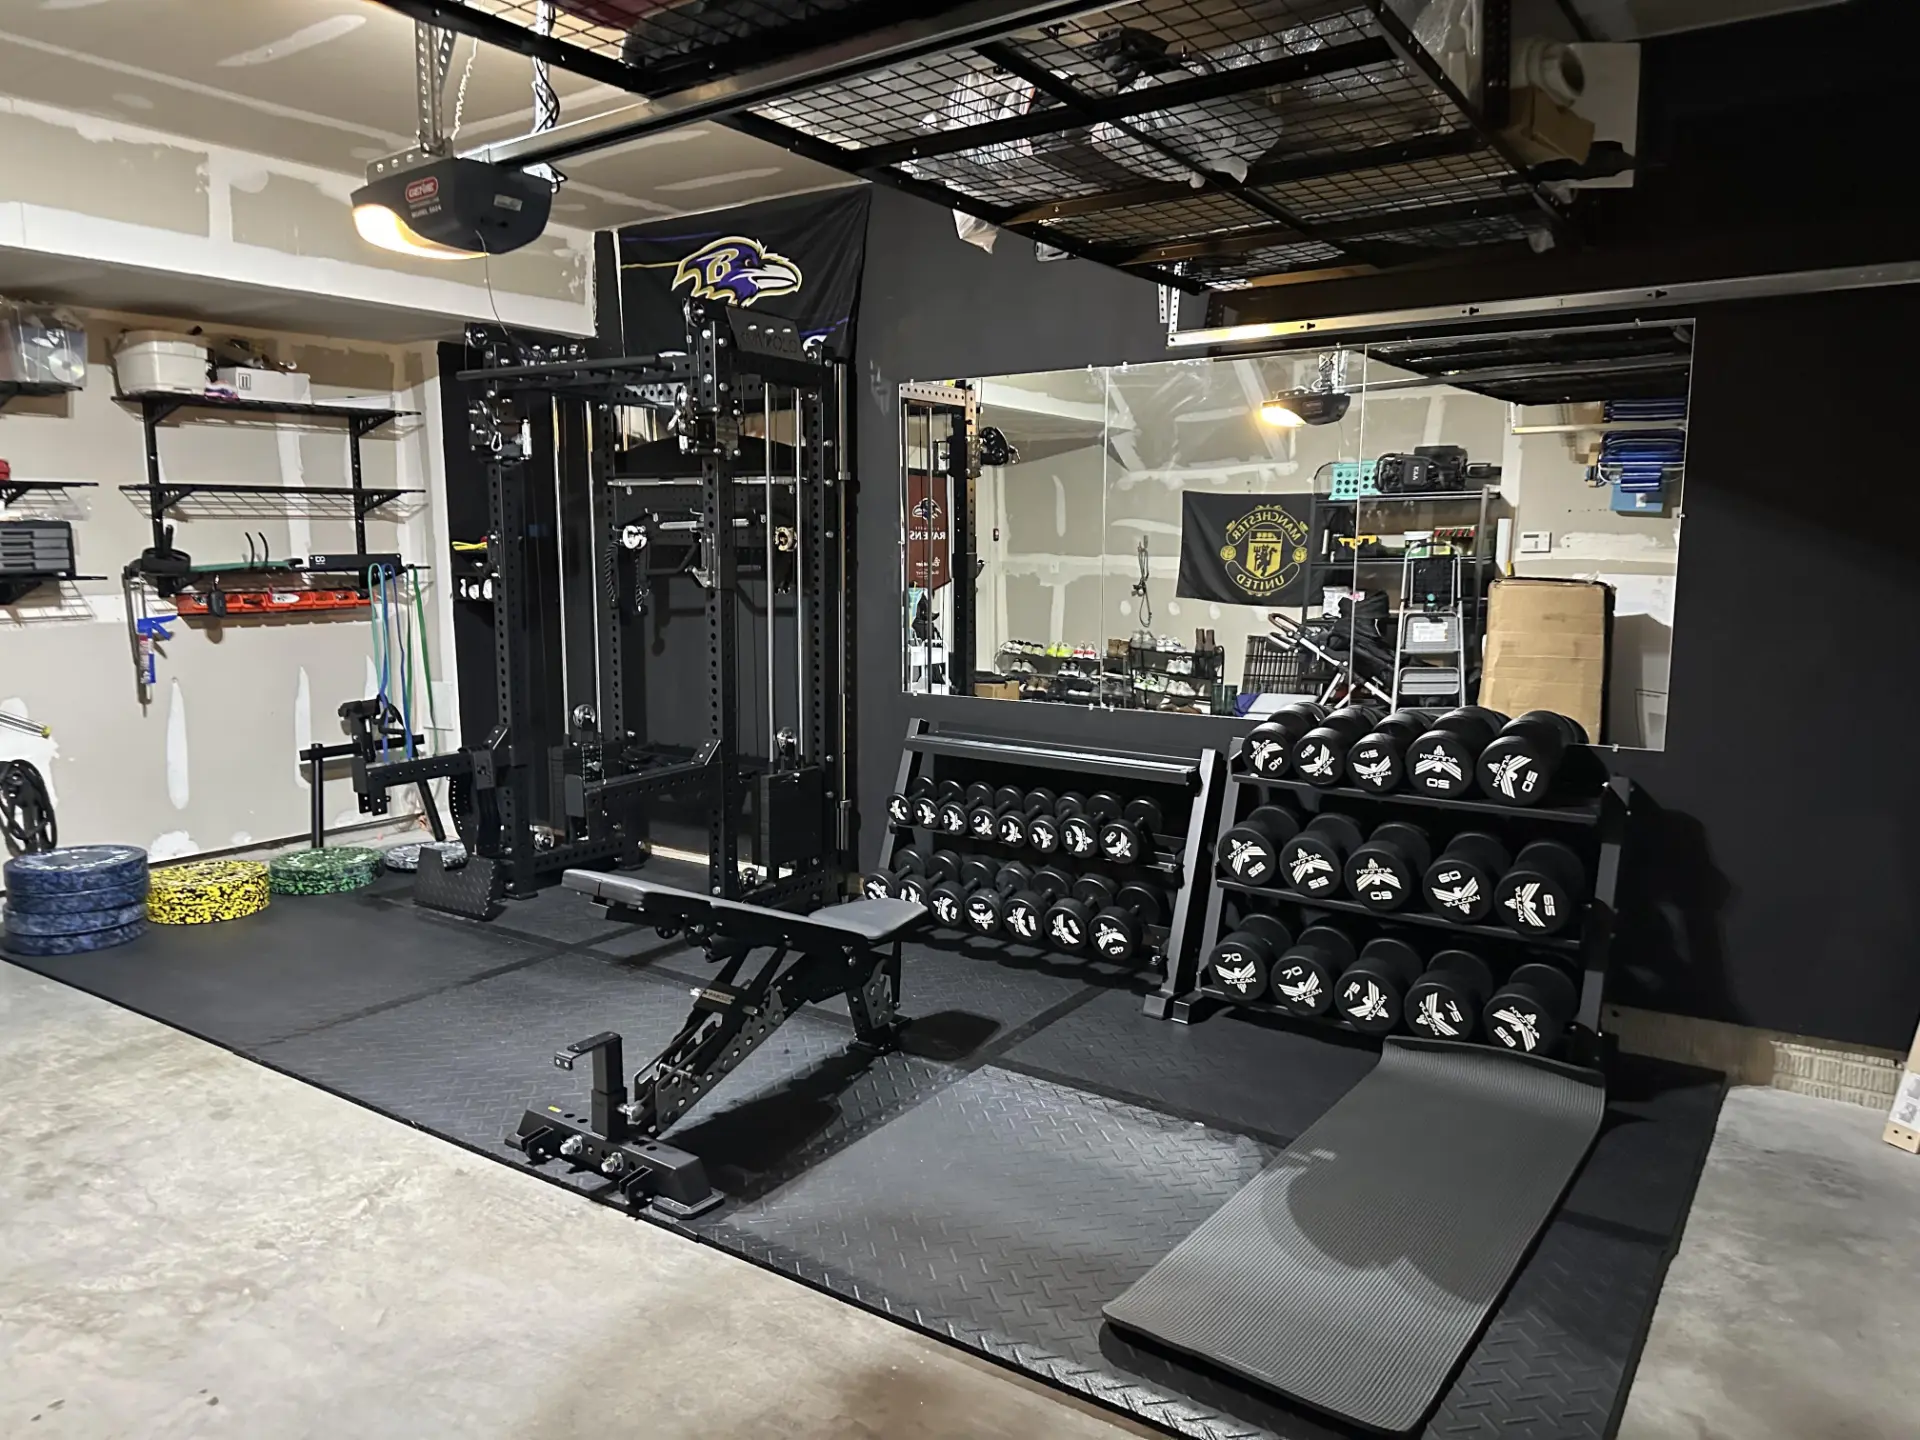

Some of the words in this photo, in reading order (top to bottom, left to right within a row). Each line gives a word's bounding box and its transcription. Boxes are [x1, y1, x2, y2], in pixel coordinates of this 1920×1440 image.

[1300, 744, 1316, 759] 45
[1359, 749, 1379, 759] 45
[1419, 752, 1458, 764] VULCAN
[1268, 757, 1283, 772] 40
[1492, 754, 1512, 788] VULCAN
[1360, 770, 1392, 780] VULCAN
[1521, 769, 1539, 793] 50
[1426, 777, 1451, 790] 50
[1227, 840, 1254, 860] VULCAN
[1289, 853, 1322, 868] VULCAN
[1247, 861, 1266, 878] 55
[1356, 867, 1393, 875] VULCAN
[1438, 870, 1461, 884] 60
[1307, 875, 1330, 890] 55
[1370, 890, 1393, 900] 60
[1443, 894, 1480, 908] VULCAN
[1514, 886, 1525, 922] VULCAN
[1543, 893, 1556, 916] 65
[1221, 952, 1242, 963] 70
[1282, 965, 1303, 980] 70
[1224, 977, 1257, 985] VULCAN
[1291, 987, 1323, 1003] VULCAN
[1343, 981, 1361, 1001] 75
[1445, 1000, 1464, 1023] 75
[1509, 1006, 1540, 1039] VULCAN
